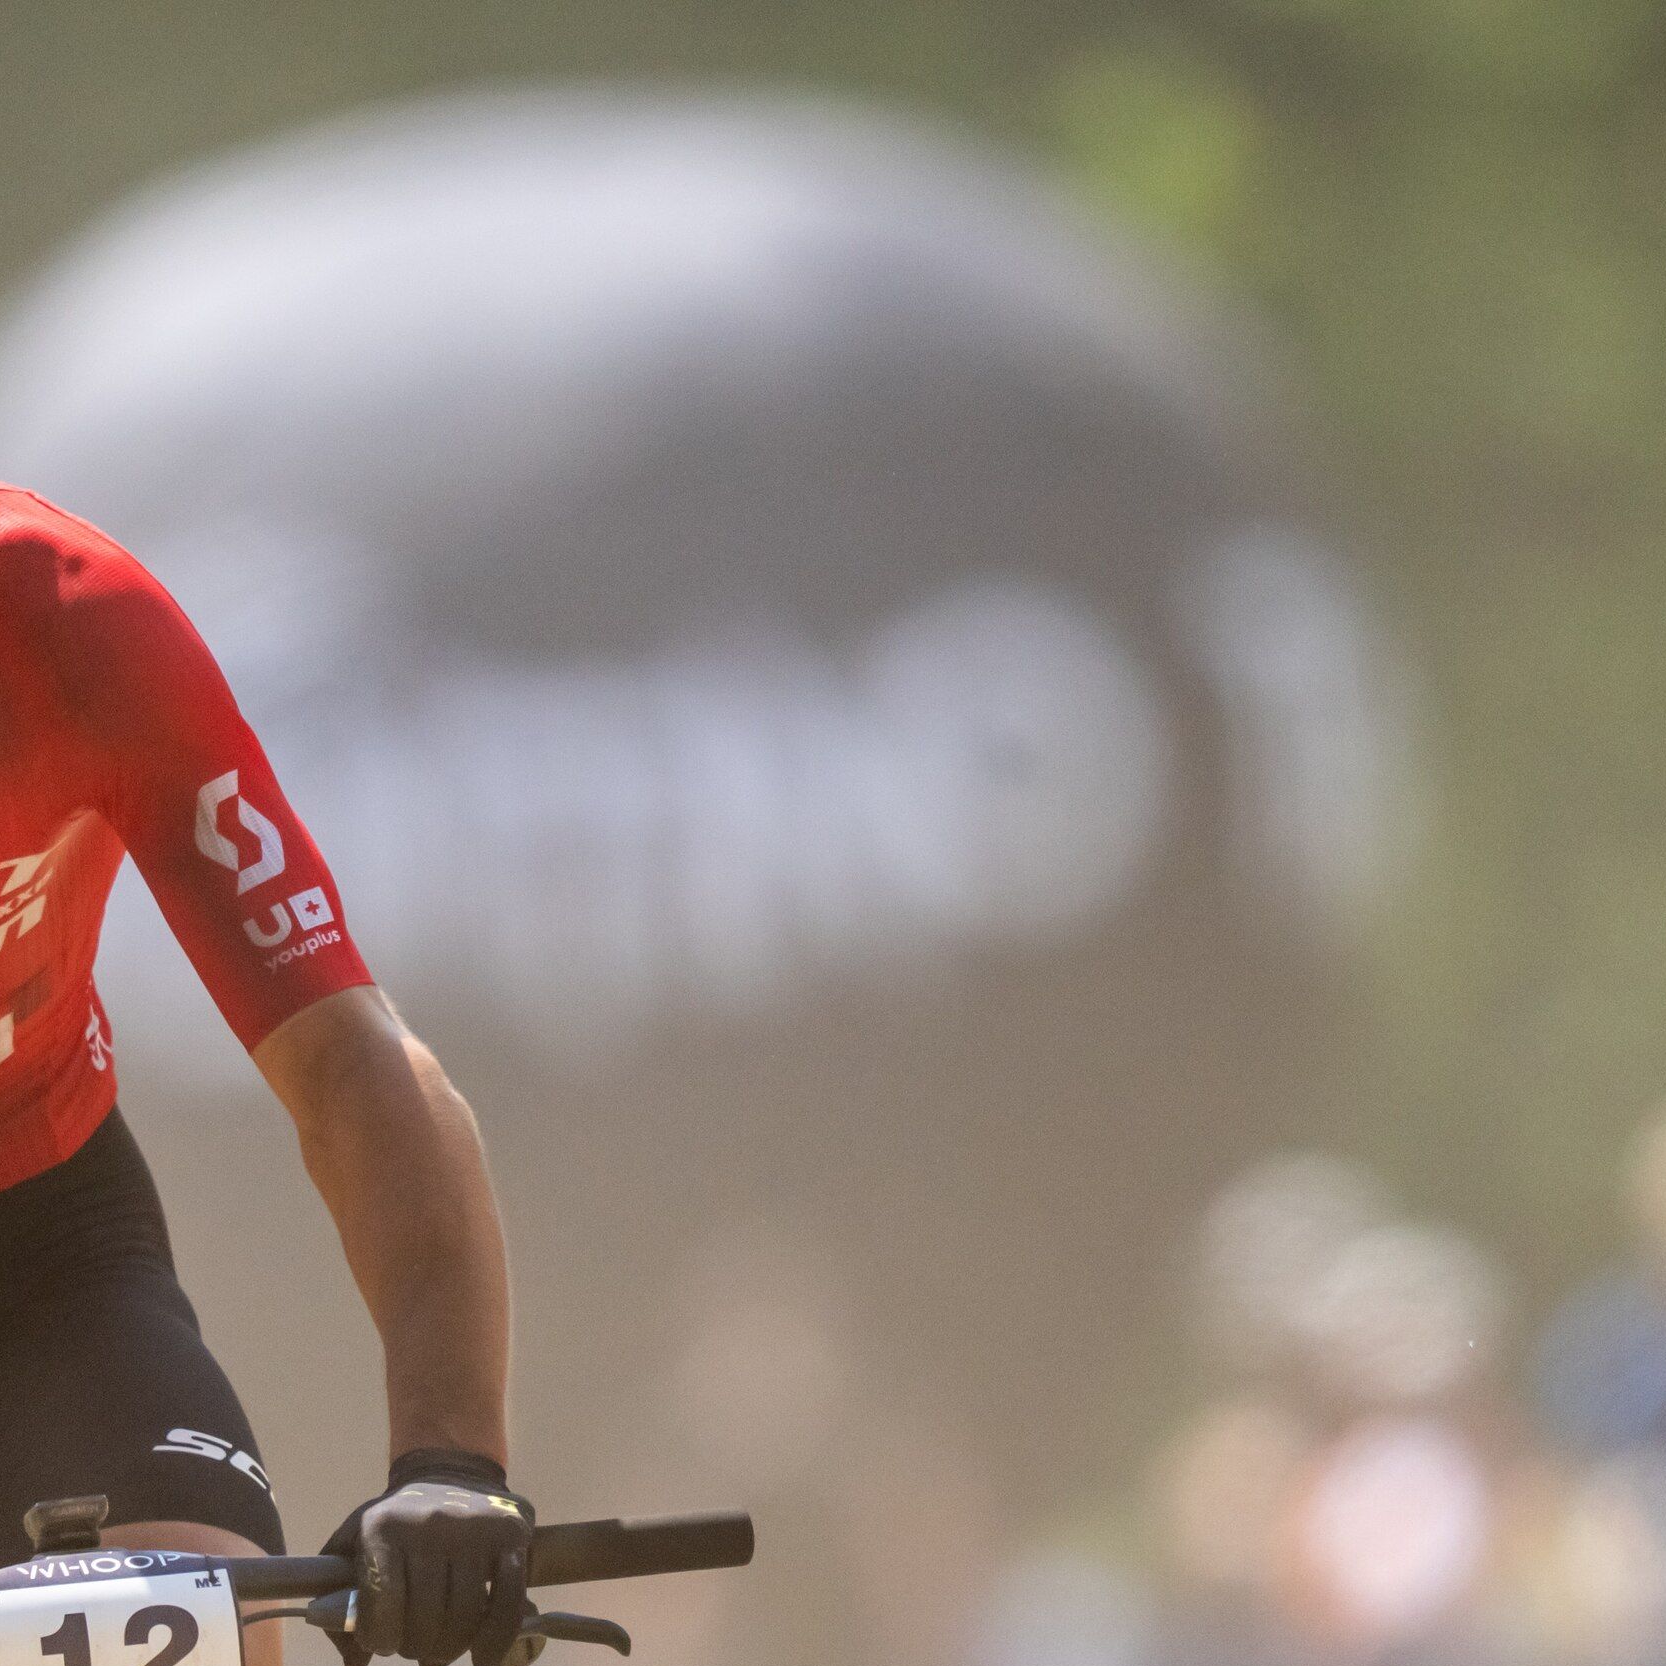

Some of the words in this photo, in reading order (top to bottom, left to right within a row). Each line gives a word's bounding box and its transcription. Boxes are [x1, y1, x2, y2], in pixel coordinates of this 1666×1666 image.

[264, 930, 341, 975] youplus
[153, 1428, 272, 1496] SC
[17, 1551, 181, 1580] WHOOP
